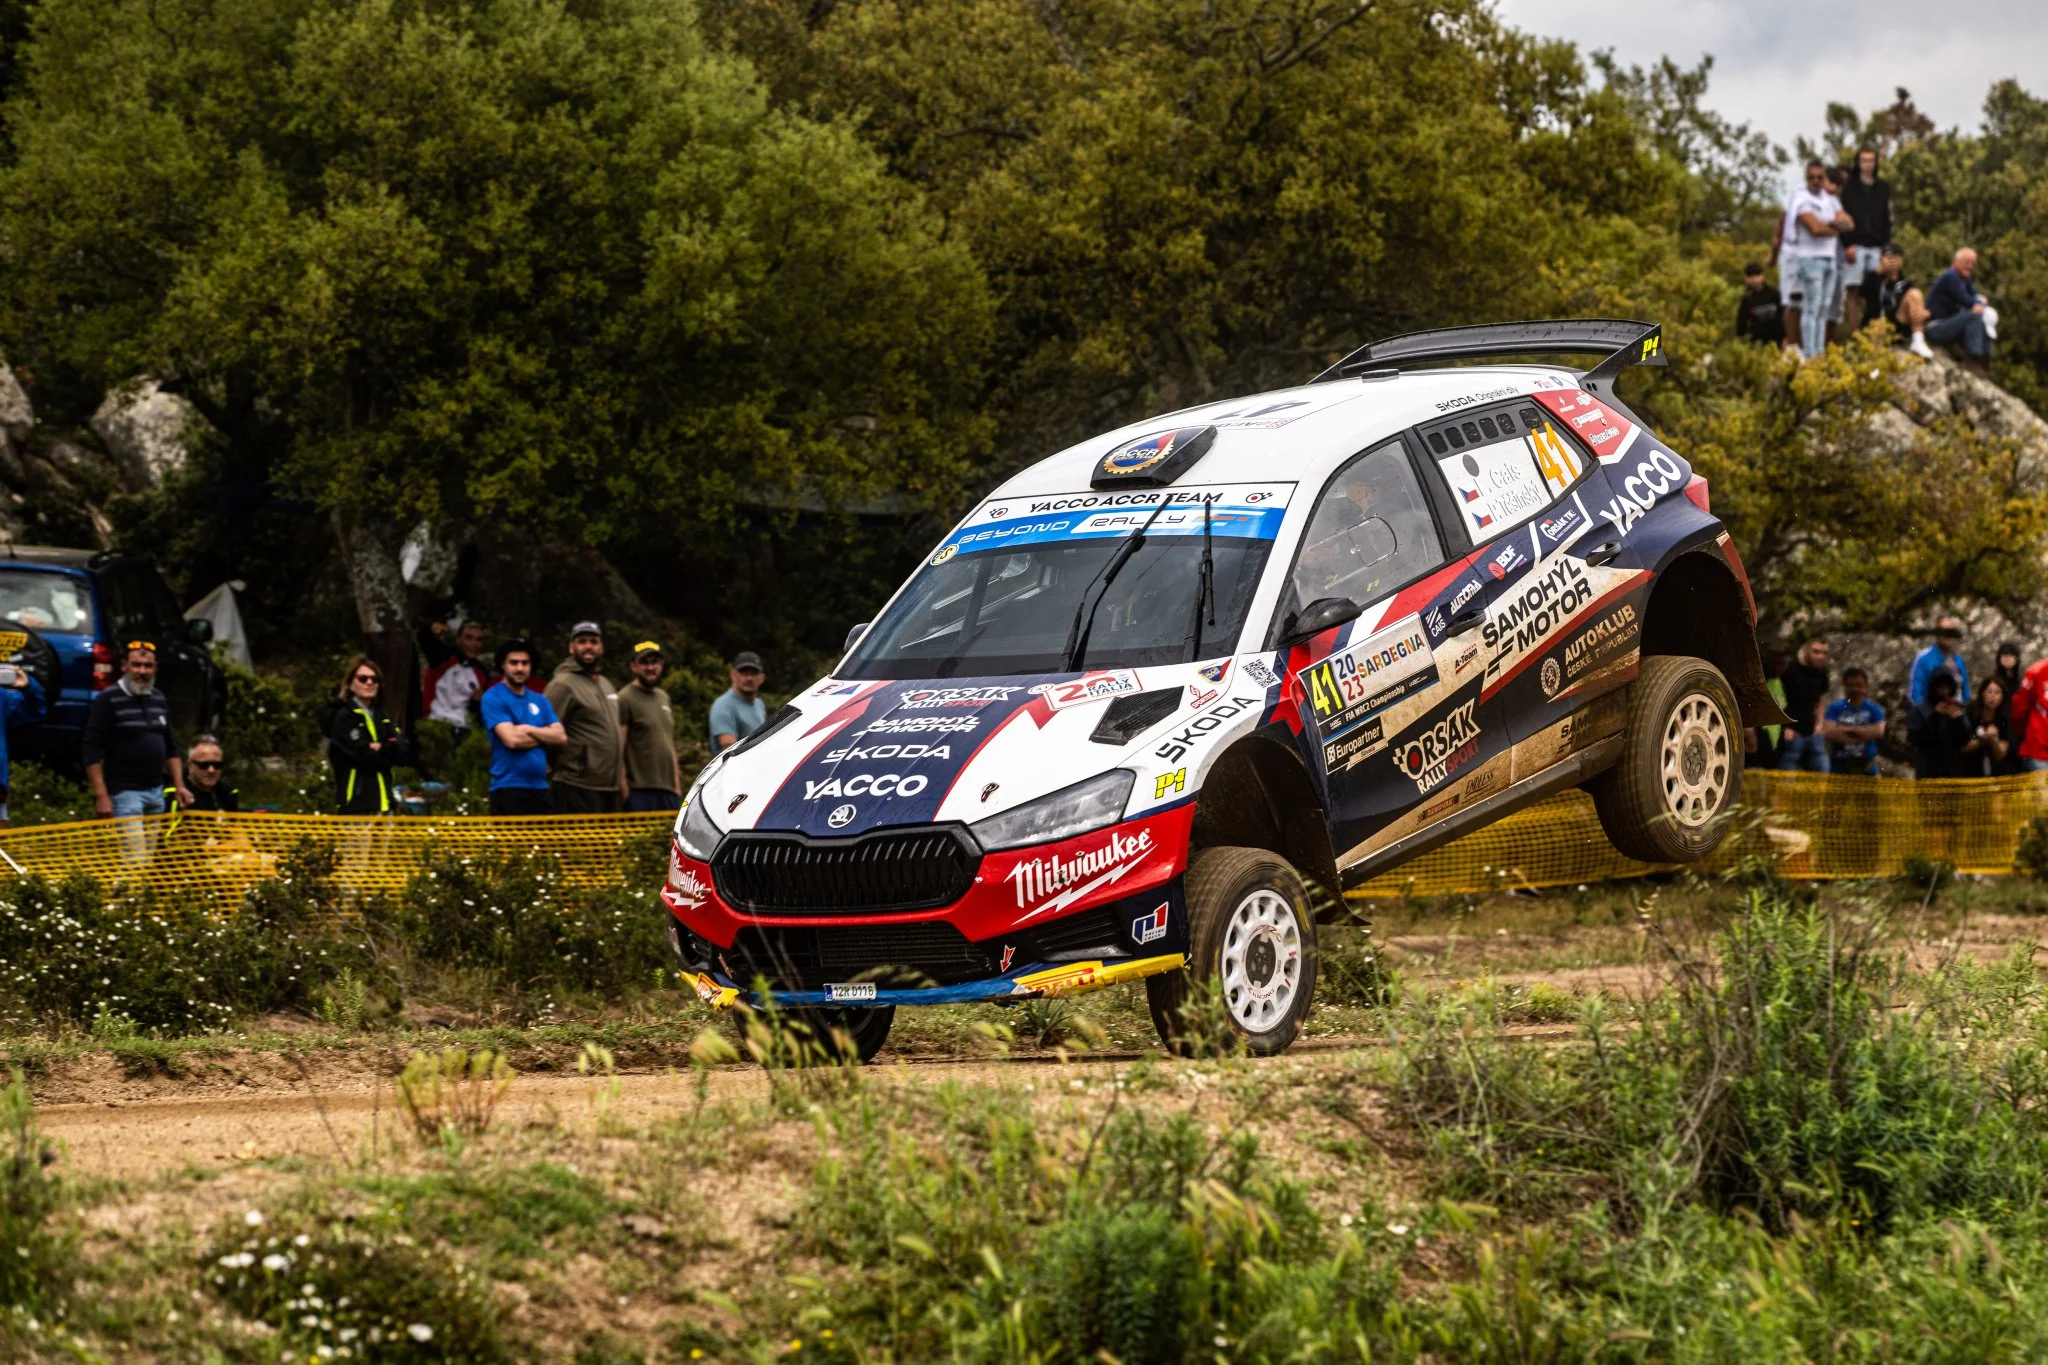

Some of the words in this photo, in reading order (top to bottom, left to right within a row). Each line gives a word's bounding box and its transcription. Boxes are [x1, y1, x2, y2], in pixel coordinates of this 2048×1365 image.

[1641, 336, 1659, 361] P1
[1531, 422, 1580, 488] 41
[1029, 497, 1099, 514] YACCO
[1099, 493, 1161, 507] ACCR
[1165, 492, 1224, 504] TEAM
[1599, 449, 1681, 537] YACCO
[958, 520, 1070, 545] BEYOND
[1496, 545, 1515, 568] BDF
[1482, 558, 1582, 648] SAMOHÝL
[1516, 577, 1593, 654] MOTOR
[1430, 618, 1446, 637] CAIS
[1565, 604, 1636, 666] AUTOKLUB
[1335, 653, 1356, 679] 20
[1356, 633, 1426, 679] SARDEGNA
[1088, 678, 1129, 692] RALLY
[1090, 683, 1133, 697] ITALIA
[1310, 663, 1343, 716] 41
[1342, 675, 1364, 702] 23
[1345, 710, 1356, 722] FIA
[1370, 685, 1405, 709] Championship
[886, 724, 977, 733] MOTOR
[1335, 726, 1380, 759] Europartner
[803, 774, 928, 800] YACCO
[1155, 767, 1186, 799] P1
[1003, 831, 1153, 909] Milwaukee
